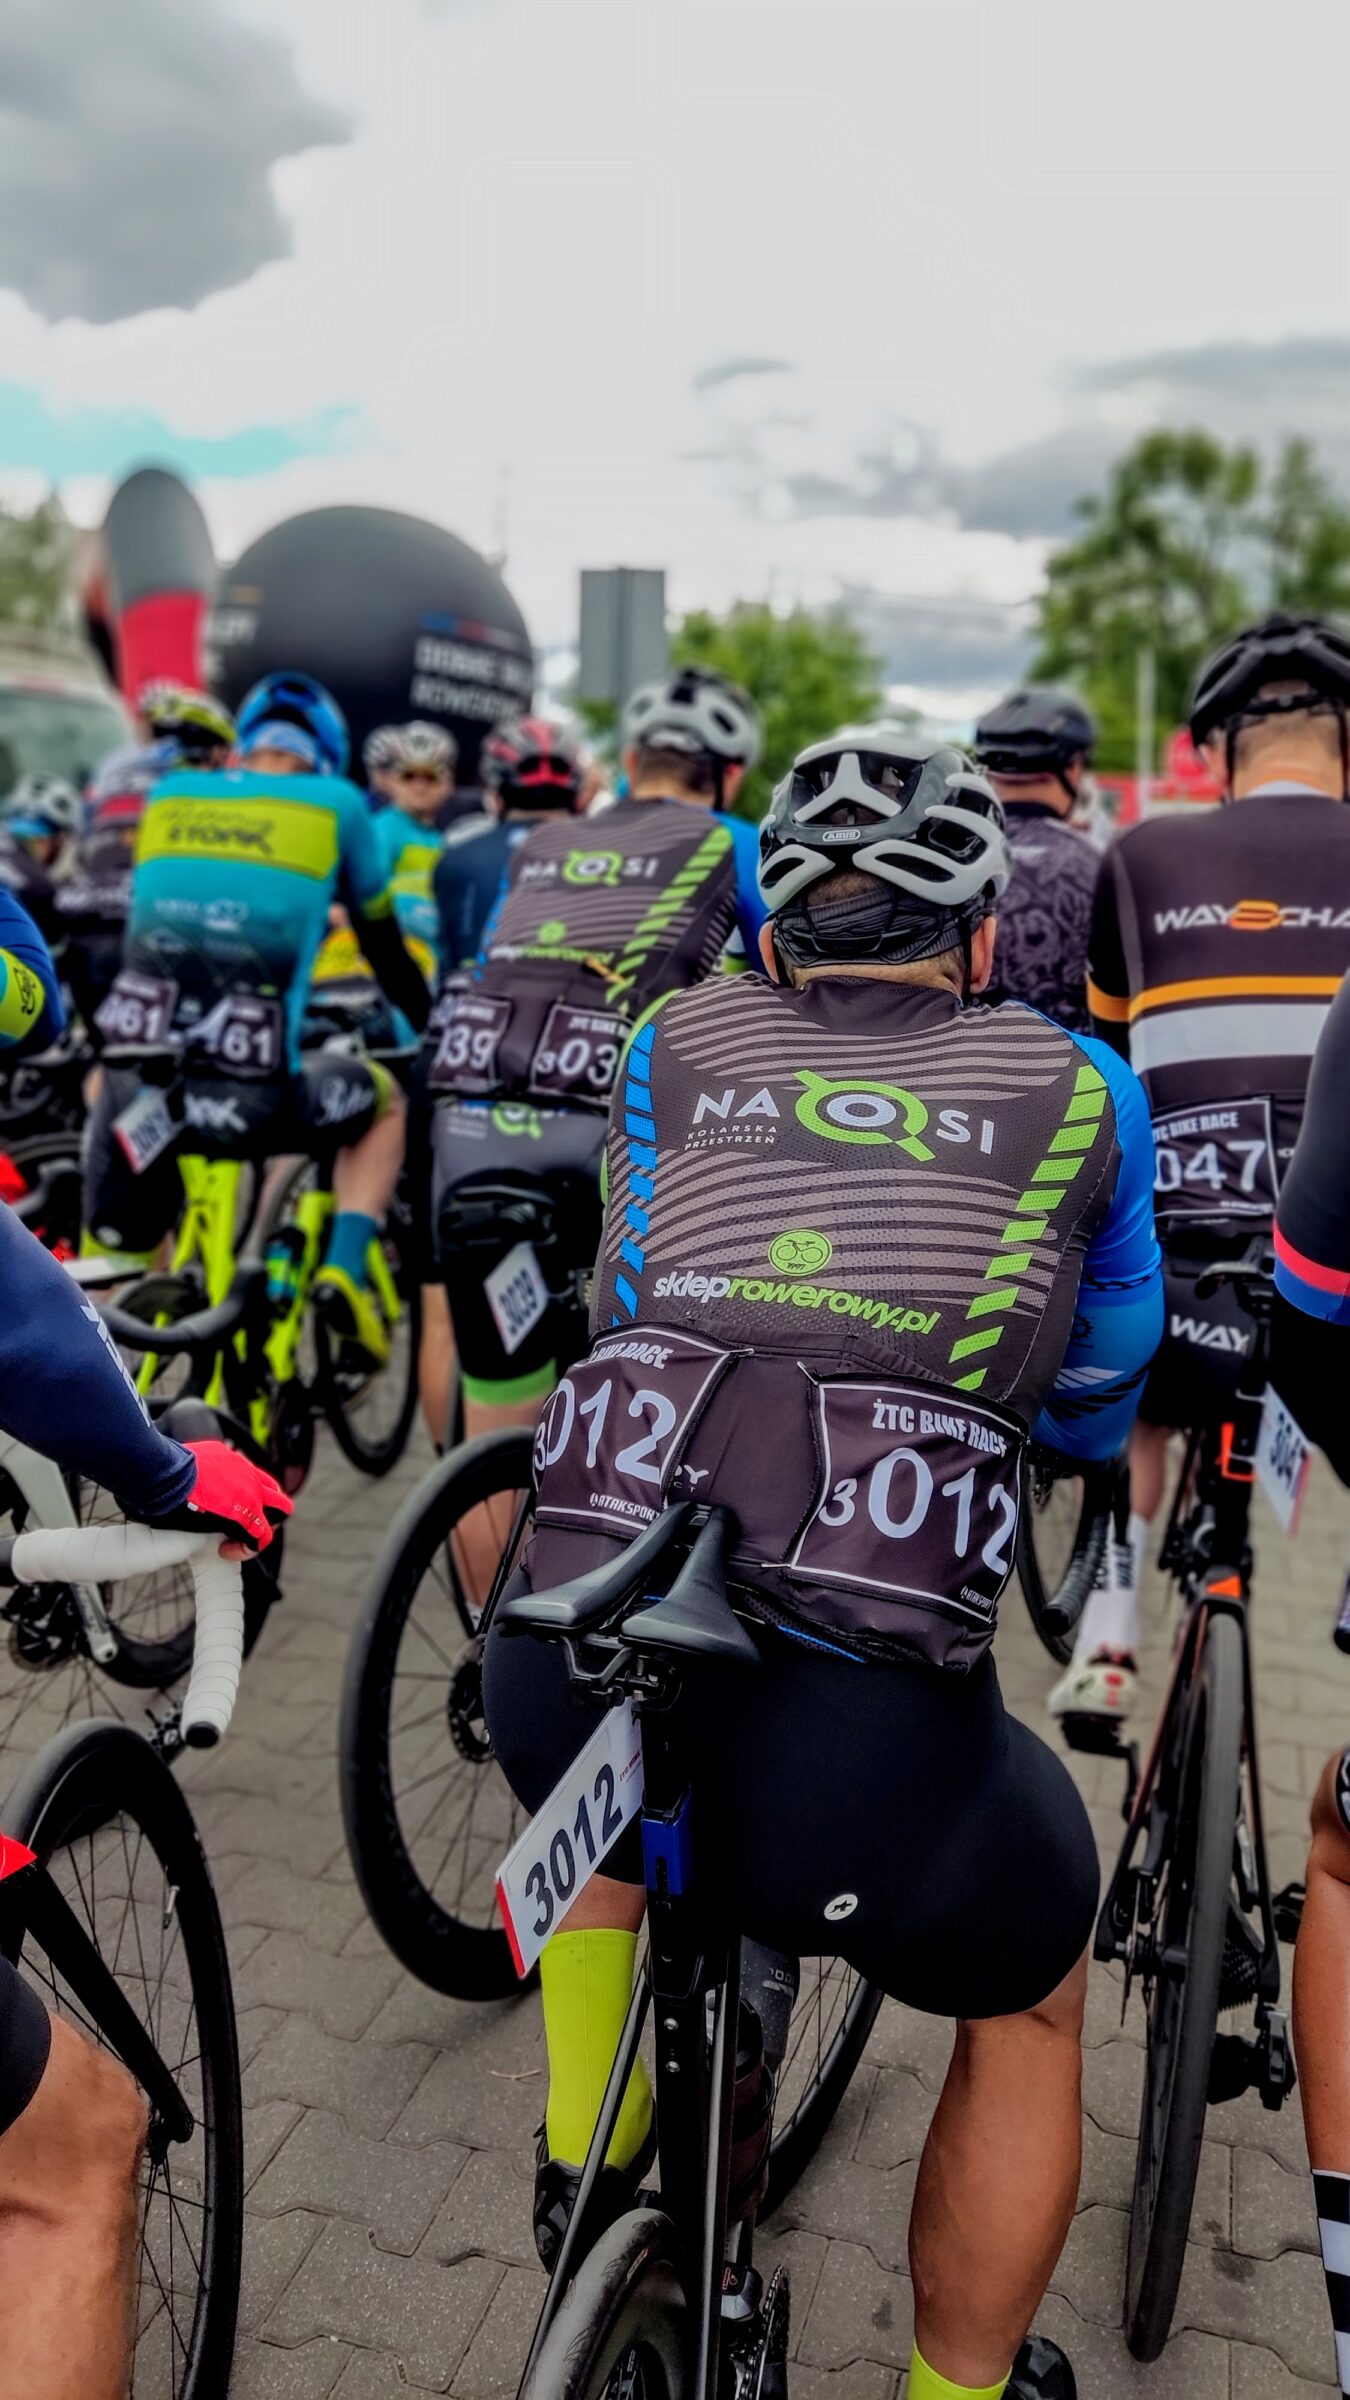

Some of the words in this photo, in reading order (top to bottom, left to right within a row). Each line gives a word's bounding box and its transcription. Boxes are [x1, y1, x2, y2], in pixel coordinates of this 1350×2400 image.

[826, 831, 857, 840] ABUS
[687, 1124, 777, 1140] KOLARSKA
[1169, 1114, 1200, 1139] BIKE
[1200, 1110, 1240, 1132] RACE
[684, 1134, 776, 1151] PRZESTRZEŃ
[653, 1270, 941, 1335] skleprowerowy.pl
[1170, 1313, 1250, 1354] WAY
[616, 1342, 674, 1371] RACE
[872, 1398, 915, 1434] ŻTC
[818, 1446, 1017, 1577] 3012
[524, 1762, 624, 1938] 3012
